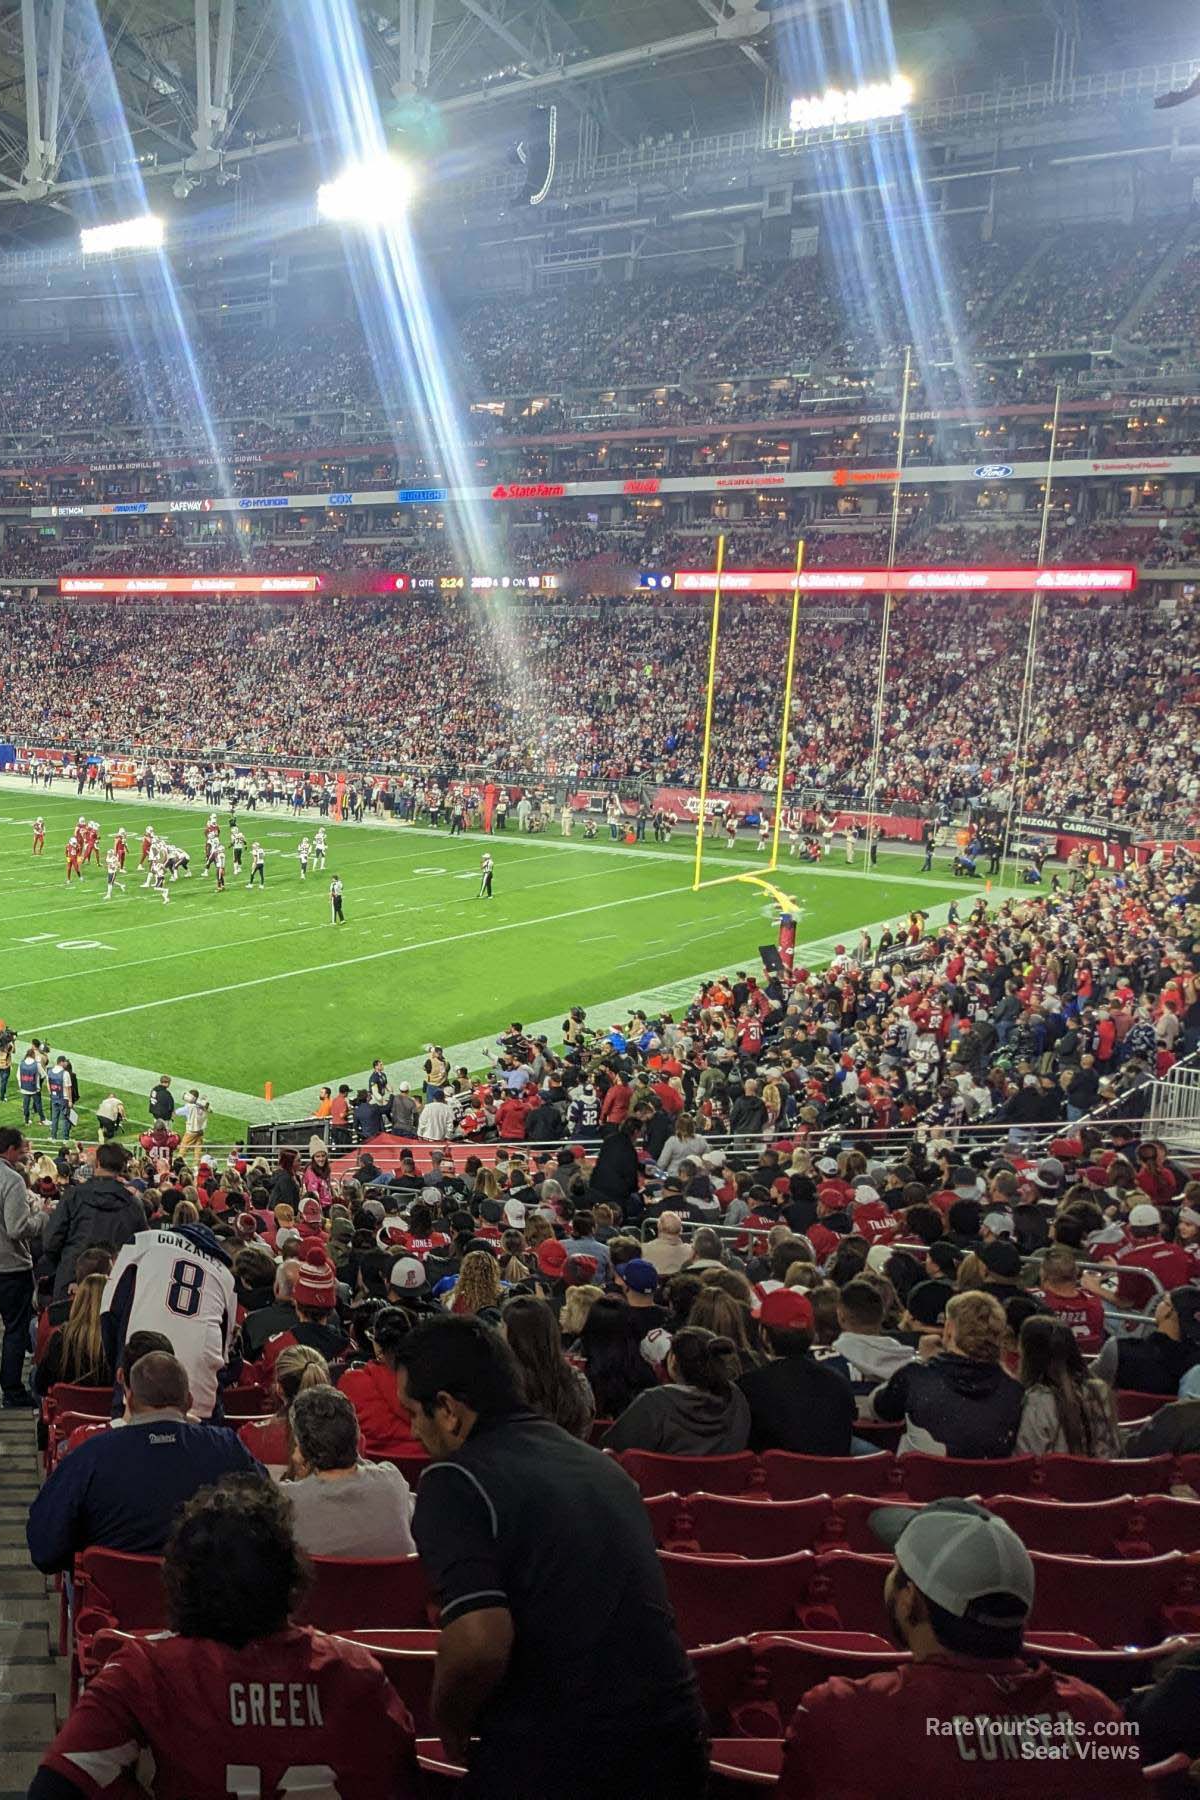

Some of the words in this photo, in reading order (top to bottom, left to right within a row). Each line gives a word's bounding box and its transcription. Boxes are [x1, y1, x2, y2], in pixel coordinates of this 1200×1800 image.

[1129, 396, 1188, 408] CHARLEY
[859, 415, 896, 424] ROGER
[89, 464, 117, 472] CHARLES
[980, 466, 1008, 478] Ford
[328, 494, 353, 504] COX
[58, 507, 84, 516] BETMGM
[170, 501, 202, 512] SAFEWAY
[418, 579, 434, 587] QTR
[440, 577, 465, 589] 3:24
[512, 579, 526, 587] ON
[1014, 816, 1058, 829] ARIZONA
[1062, 822, 1108, 836] CARDINALS
[10, 932, 120, 951] 10
[582, 1110, 598, 1126] 32
[149, 1145, 170, 1160] 40
[411, 1238, 433, 1248] JONES
[166, 1258, 205, 1319] 8
[229, 1682, 324, 1727] GREEN
